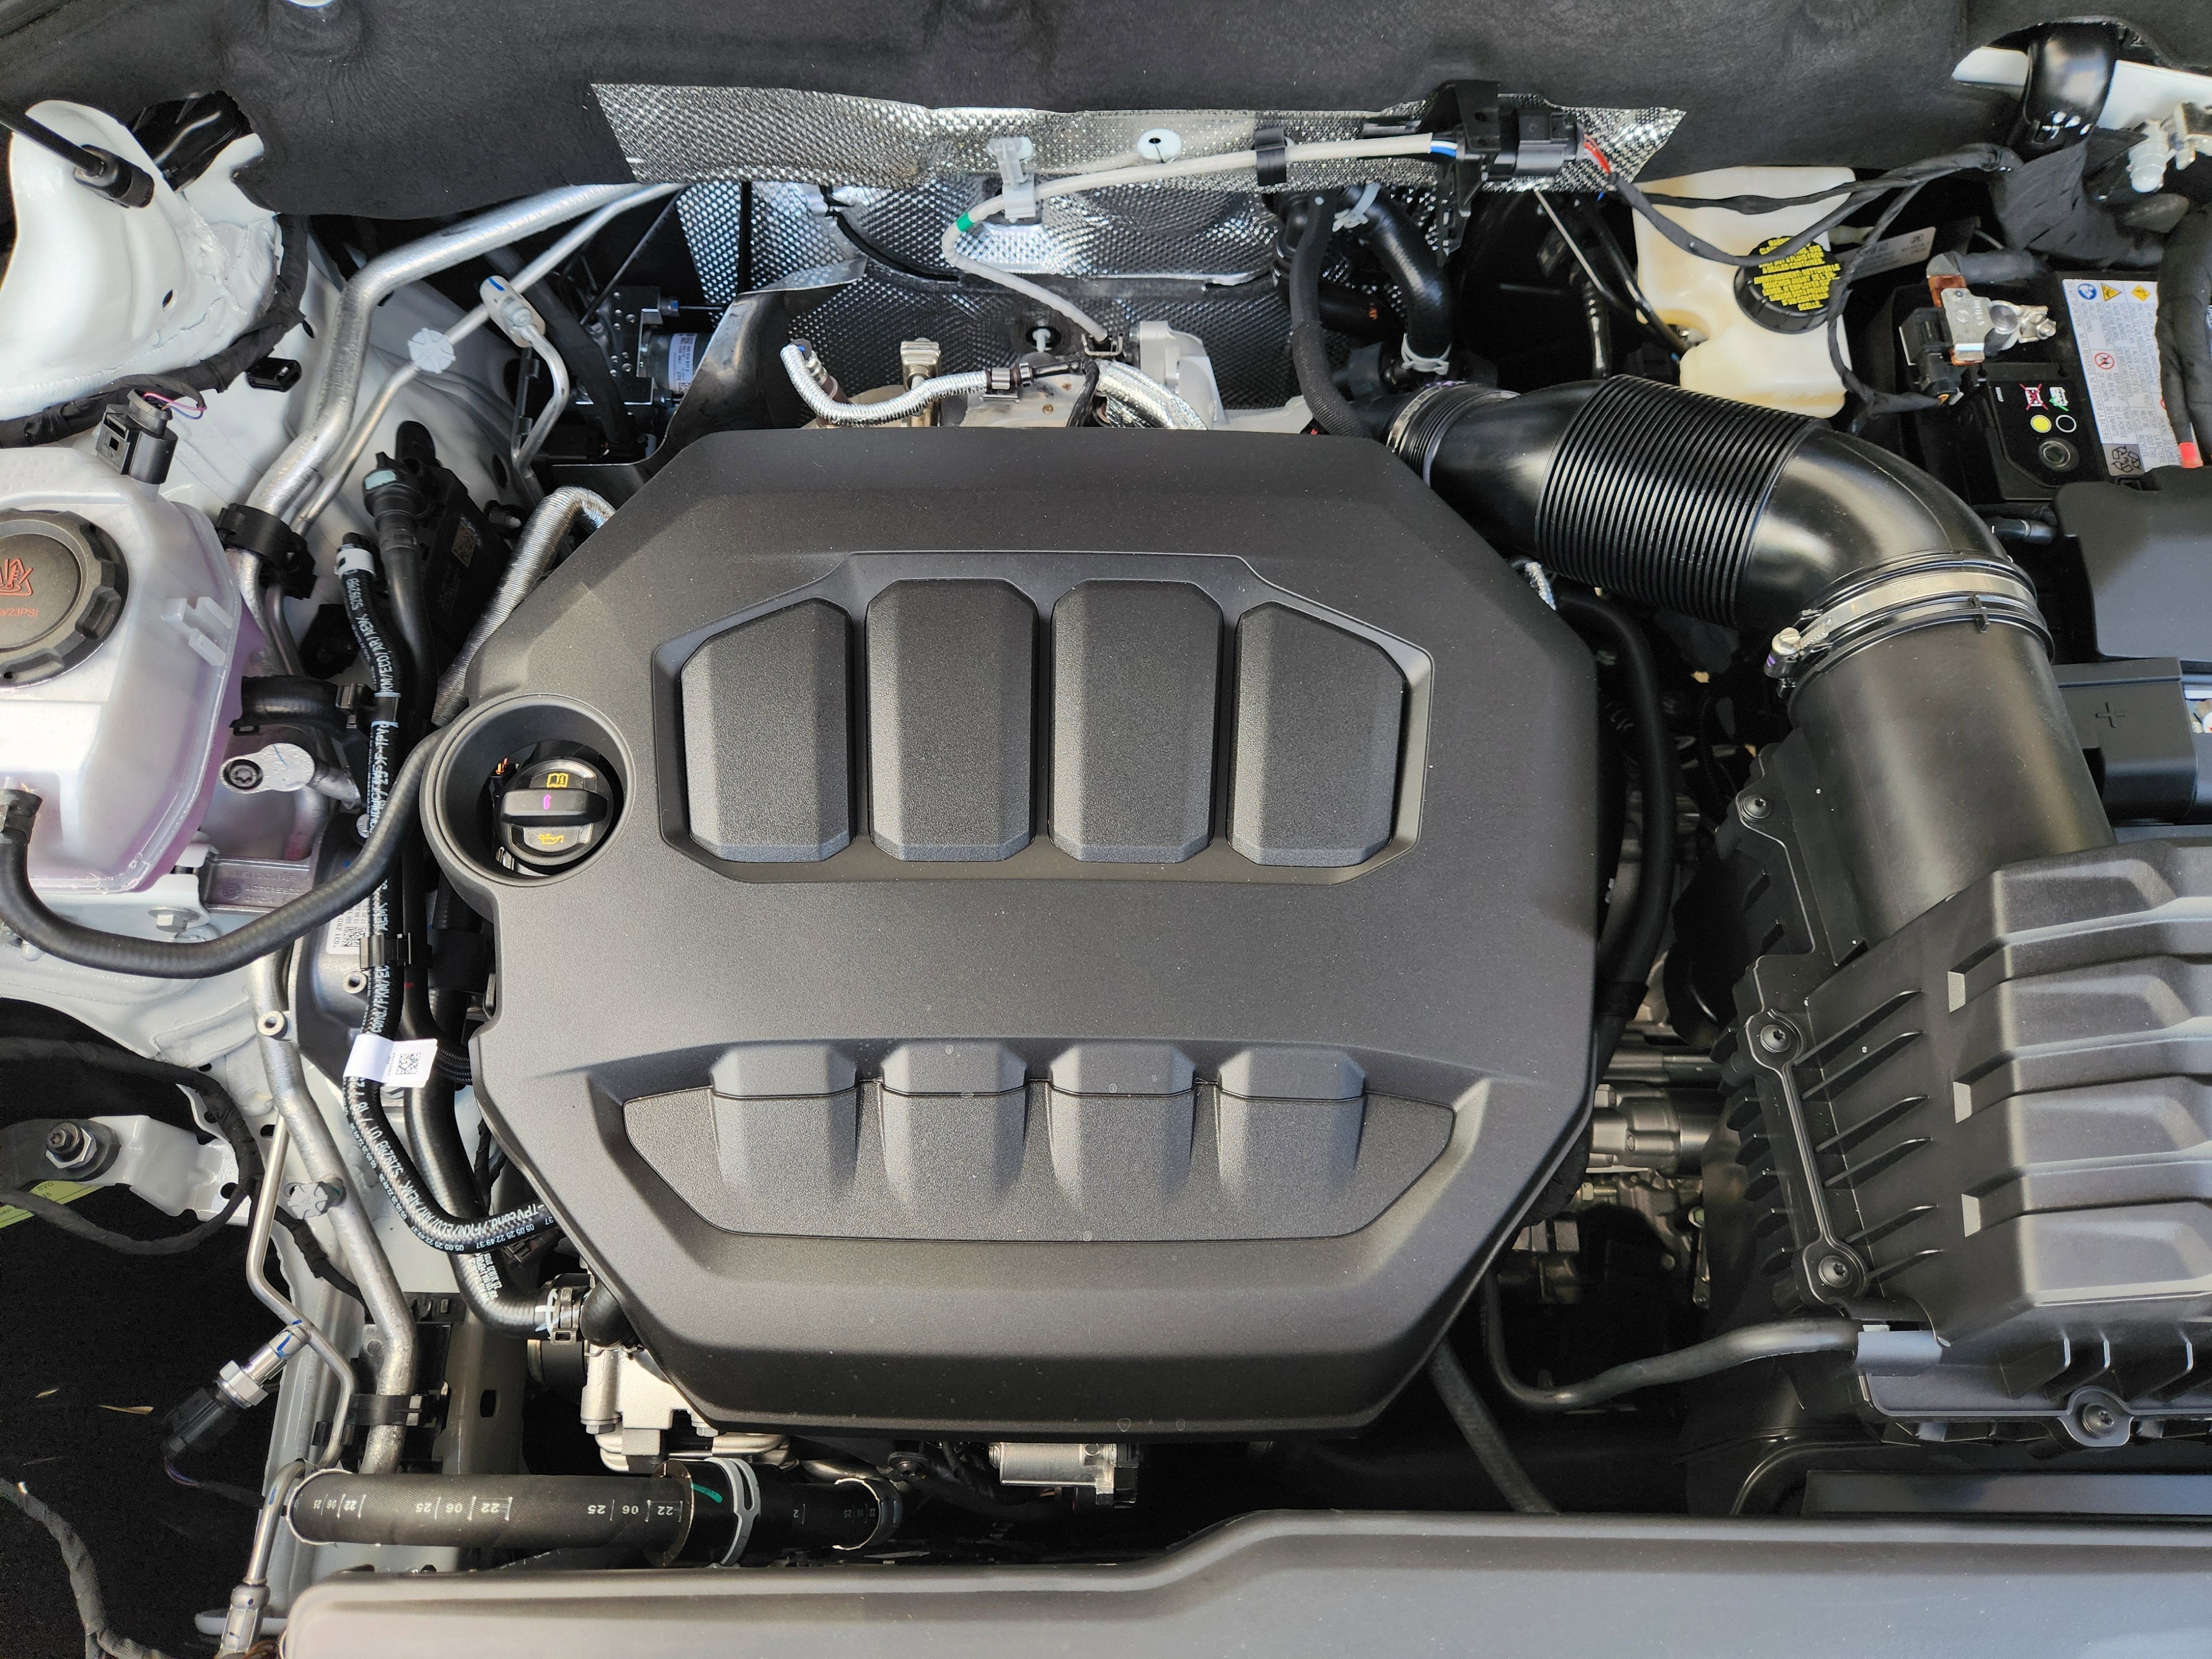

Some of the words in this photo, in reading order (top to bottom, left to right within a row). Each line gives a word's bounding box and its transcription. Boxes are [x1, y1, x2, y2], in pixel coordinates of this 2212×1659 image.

[476, 1234, 506, 1249] 22:49:37
[314, 1500, 322, 1510] 25
[327, 1500, 337, 1510] 06
[344, 1500, 357, 1511] 22
[416, 1503, 432, 1513] 25
[446, 1503, 463, 1513] 06
[481, 1503, 500, 1513] 22
[587, 1505, 606, 1514] 25
[622, 1505, 639, 1514] 06
[657, 1505, 674, 1515] 22
